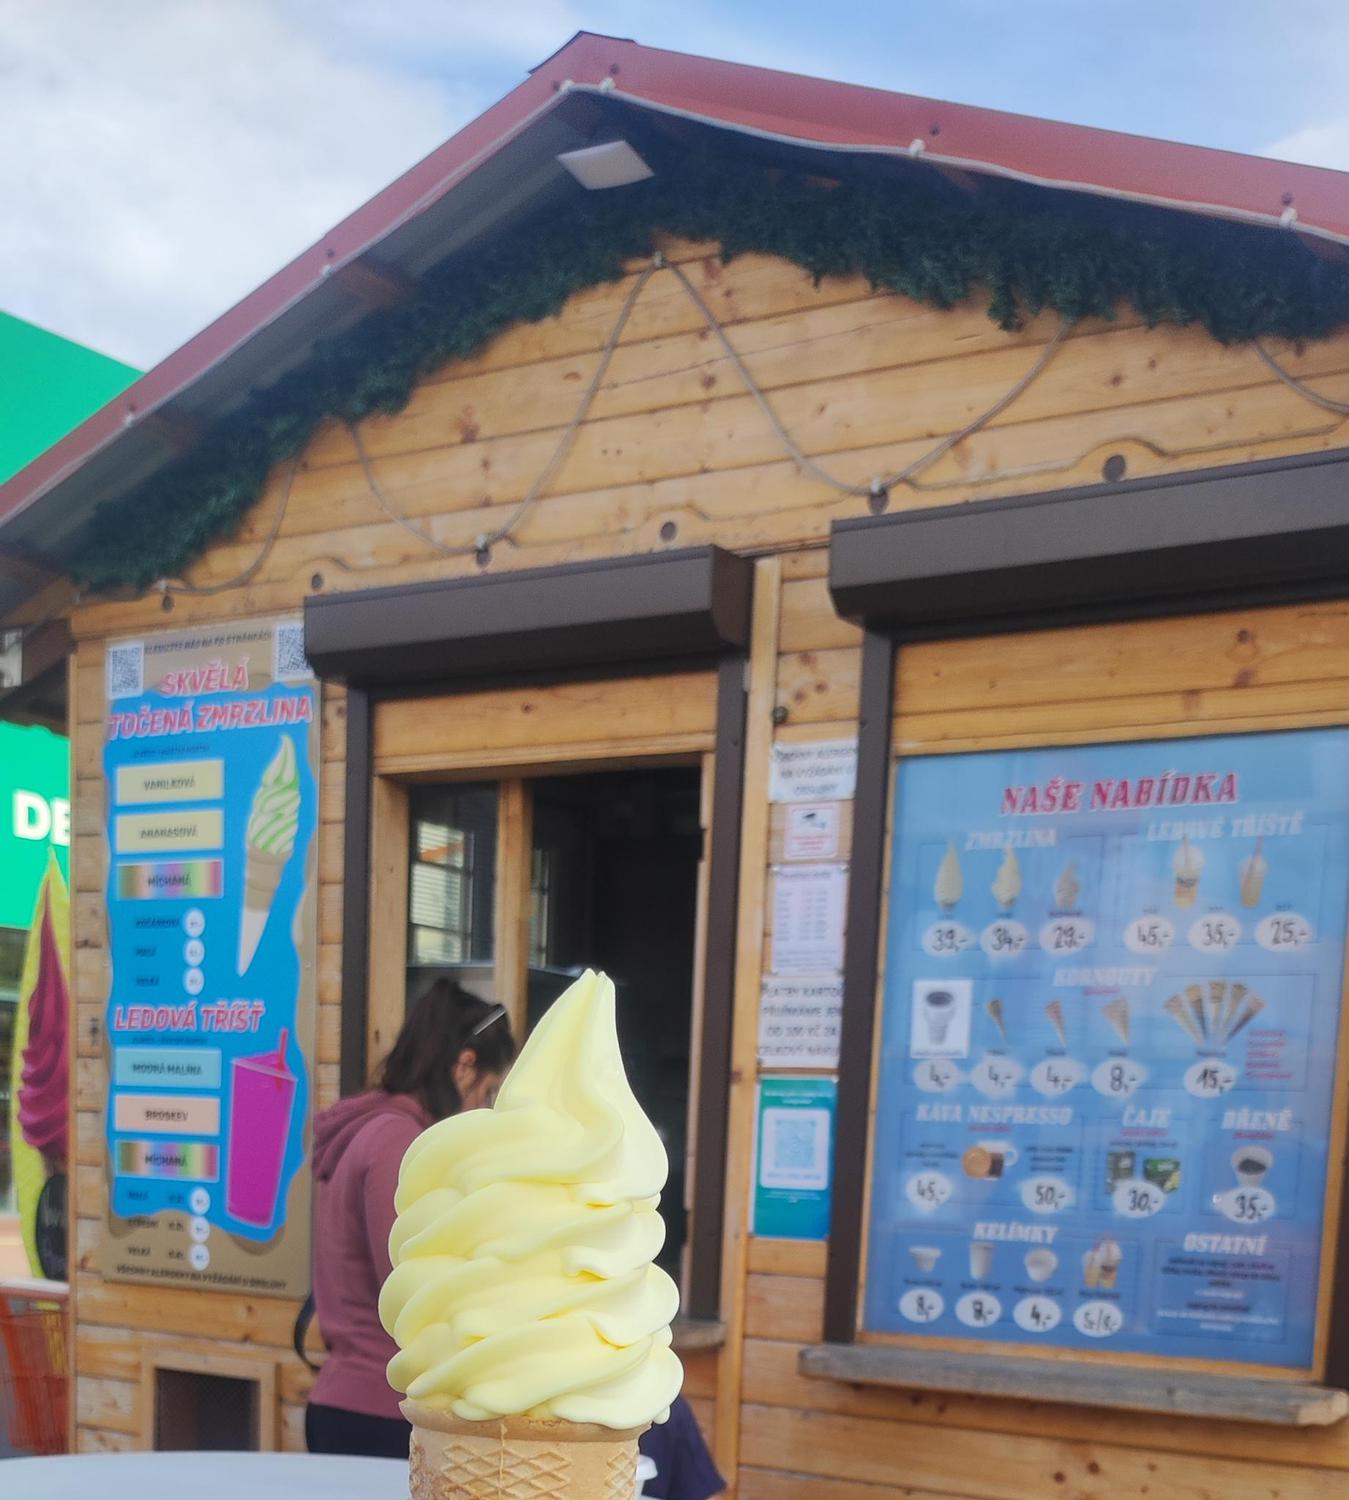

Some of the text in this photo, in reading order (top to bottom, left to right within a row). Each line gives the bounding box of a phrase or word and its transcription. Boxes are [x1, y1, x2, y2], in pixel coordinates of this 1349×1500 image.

[159, 657, 250, 698] SKVĚLÁ
[108, 696, 313, 740] TOČENÁ ZMRZLINA
[143, 776, 195, 791] VANILKOVÁ
[1000, 767, 1239, 816] NAŠE NABÍDKA
[140, 824, 197, 840] ANANASOVÁ
[965, 829, 1057, 851] ZMRZLINA
[1147, 816, 1226, 842] LEDOVÉ
[147, 872, 192, 889] MÍCHANÁ
[1137, 923, 1169, 948] 45,-
[1202, 922, 1235, 949] 35,-
[1271, 919, 1307, 946] 25,-
[114, 999, 265, 1033] LEDOVÁ TŘÍŠŤ
[132, 1062, 202, 1075] MODRÁ MALINA
[1110, 1064, 1136, 1093] 8,-
[1197, 1068, 1232, 1094] 15,-
[145, 1110, 188, 1121] BROSKEV
[916, 1102, 1073, 1126] KÁVA NESPRESSO
[1122, 1103, 1171, 1128] ČAJE
[145, 1152, 187, 1167] MÍCHANÁ
[1035, 1185, 1065, 1209] 50,-
[973, 1222, 1059, 1245] KELÍMKY
[1184, 1231, 1268, 1257] OSTATNÍ
